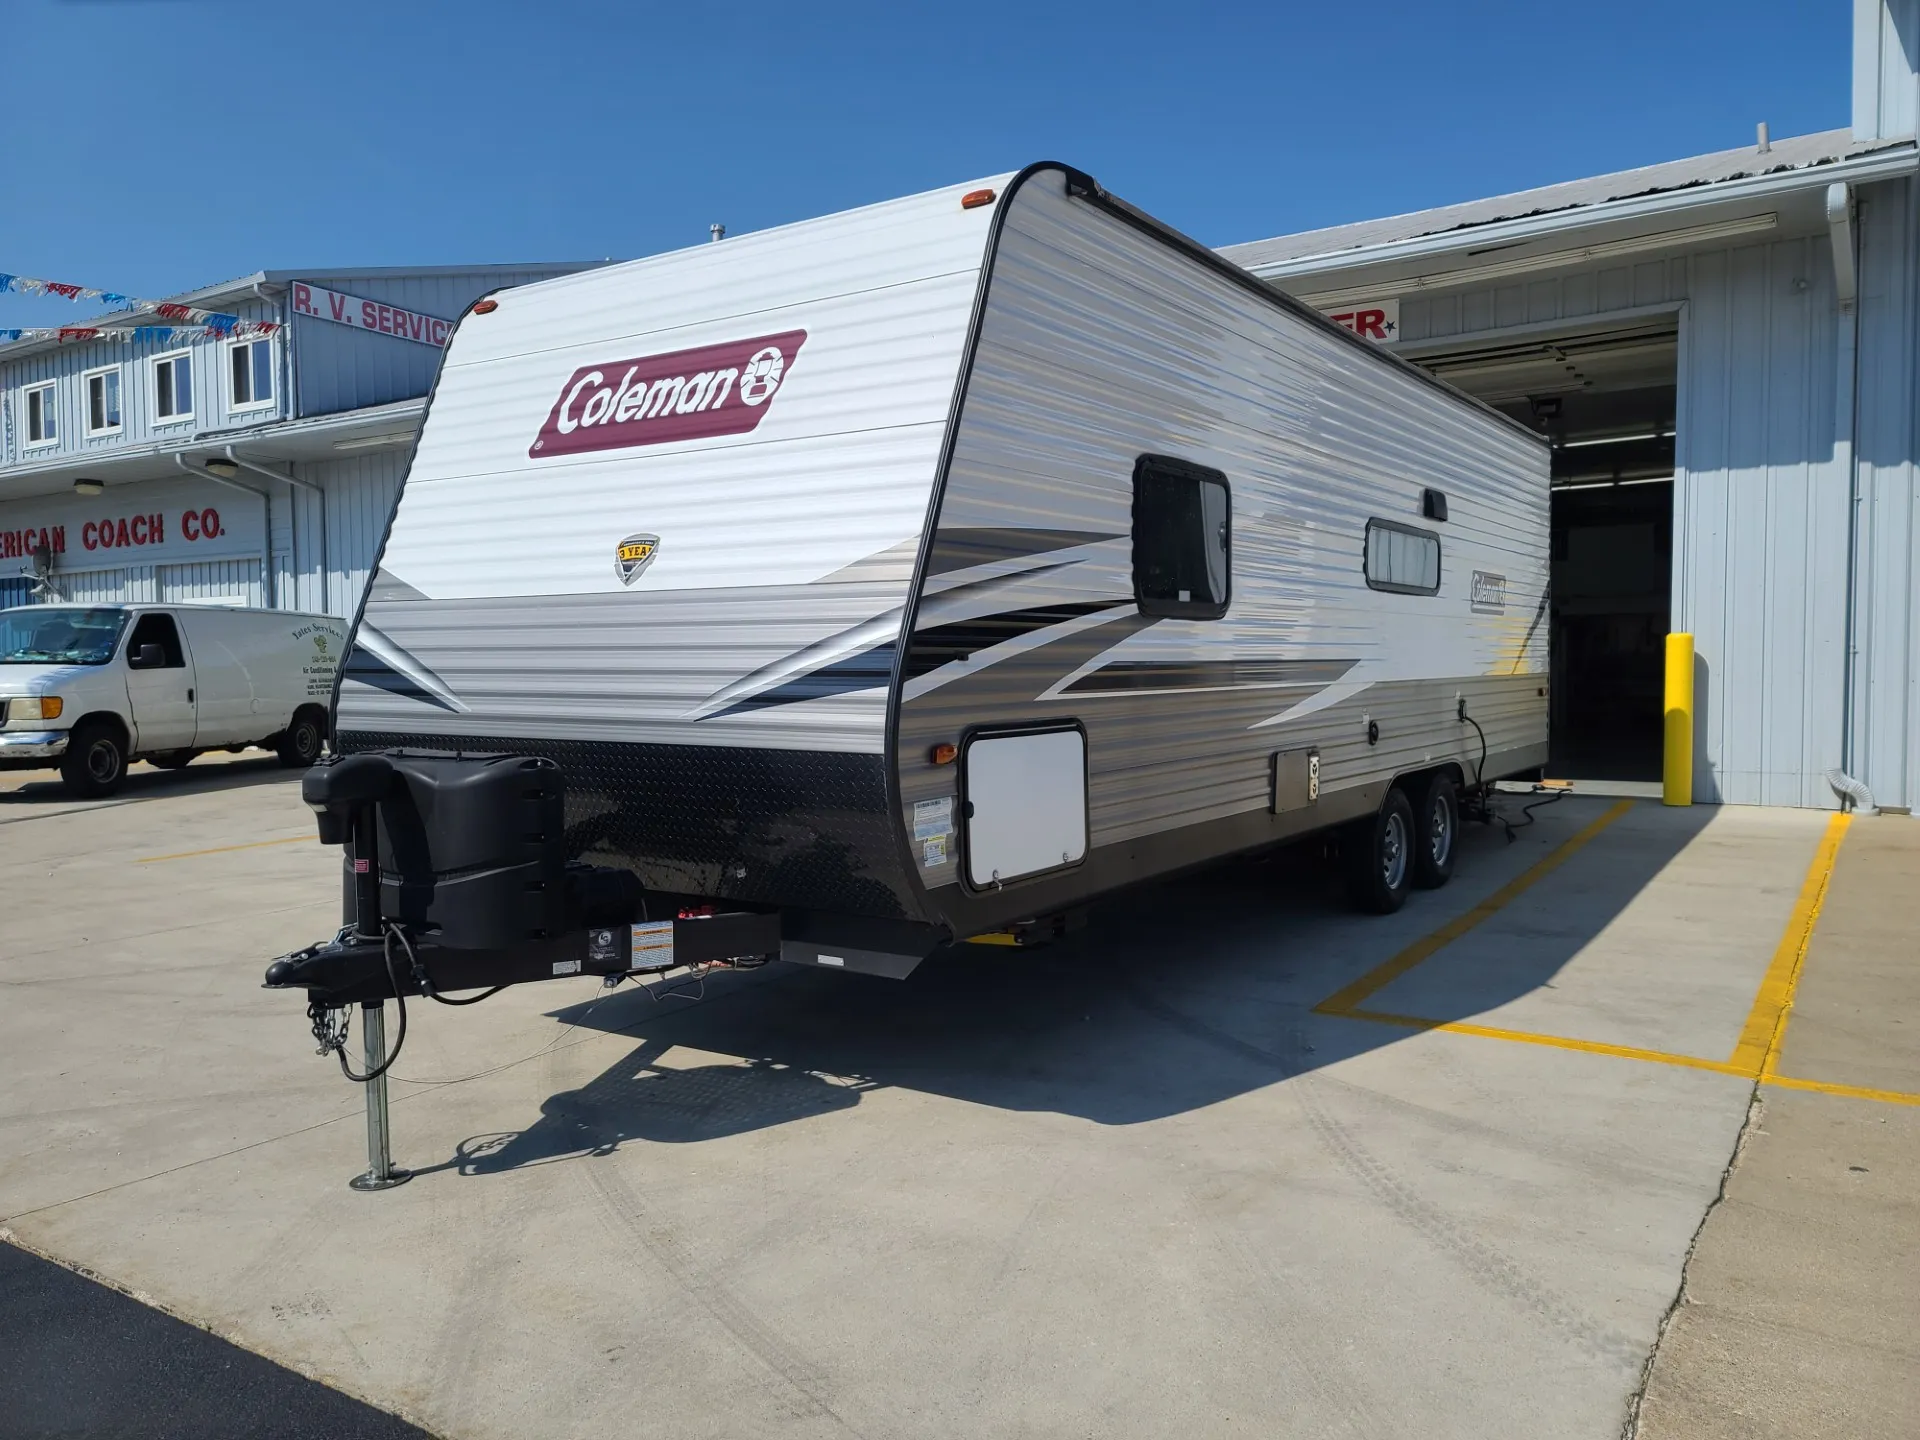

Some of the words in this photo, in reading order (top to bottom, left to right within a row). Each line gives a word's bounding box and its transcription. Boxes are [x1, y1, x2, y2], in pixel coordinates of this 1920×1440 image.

[294, 283, 318, 316] R.
[328, 292, 352, 324] V.
[361, 299, 454, 347] SERVIC
[557, 365, 739, 435] Coleman
[0, 525, 66, 559] RICAN
[82, 514, 164, 551] COACH
[181, 507, 226, 541] CO.
[619, 549, 626, 559] 3
[292, 626, 312, 640] Yates
[312, 622, 344, 640] Services
